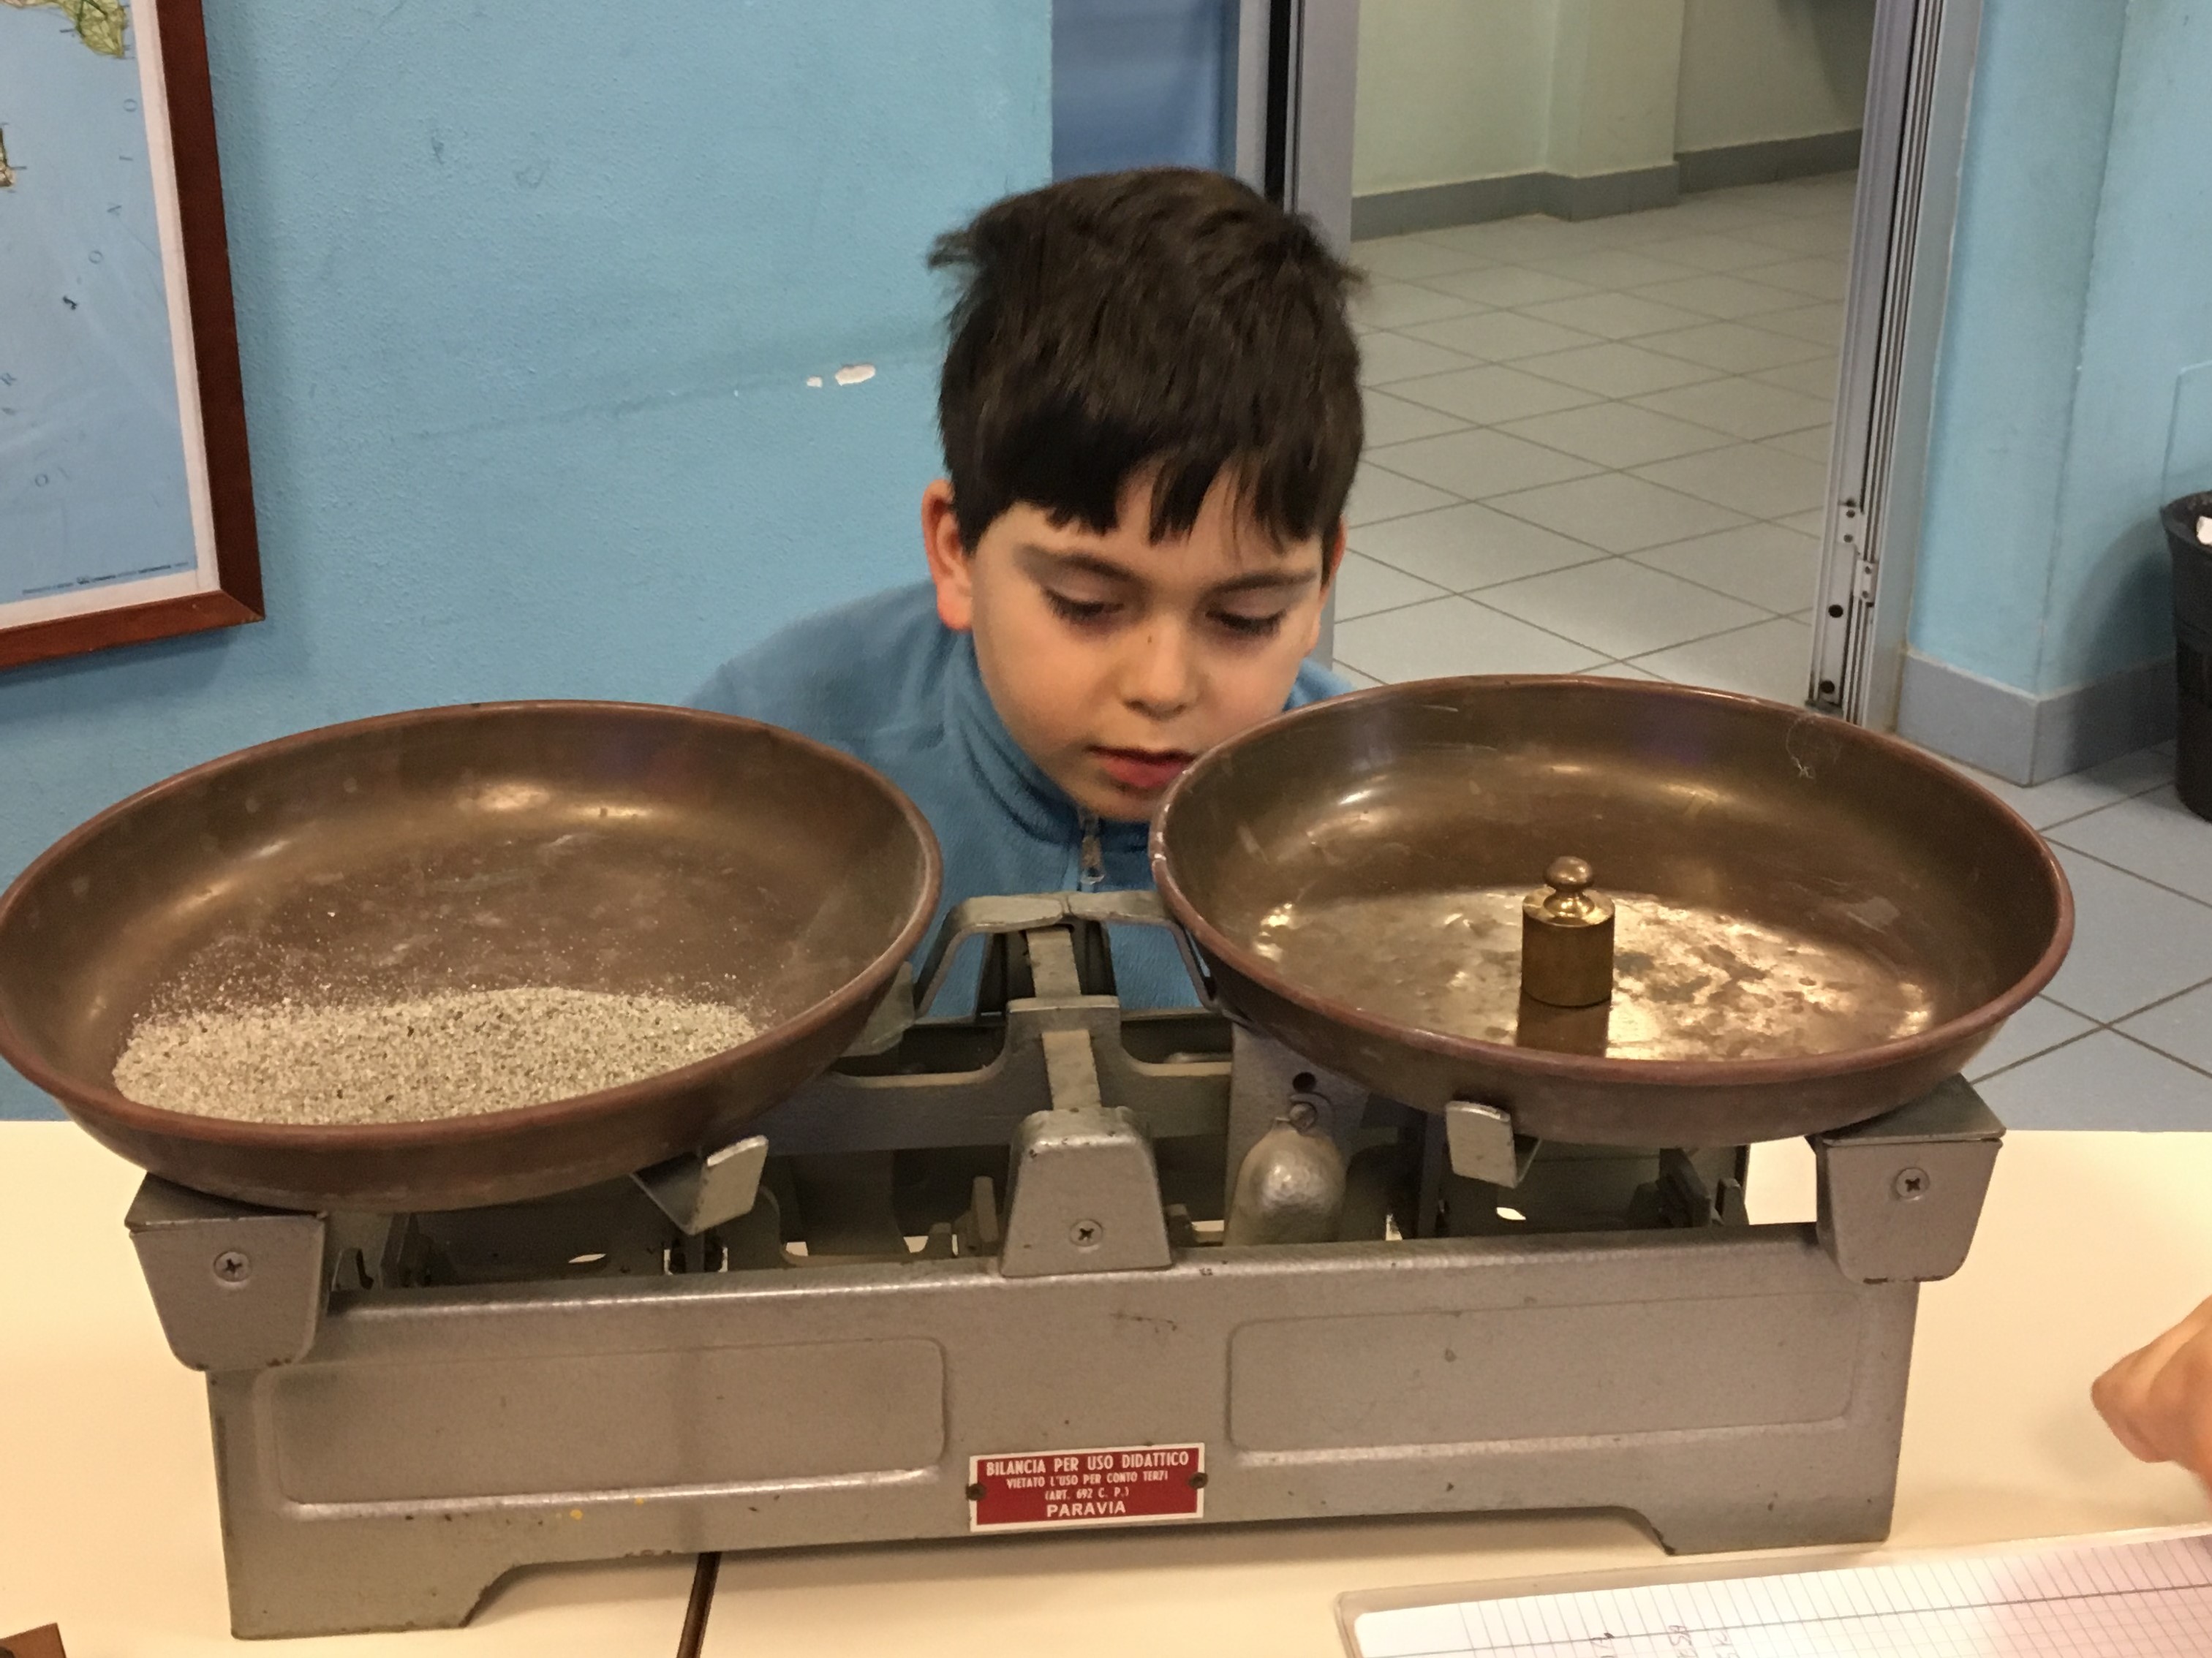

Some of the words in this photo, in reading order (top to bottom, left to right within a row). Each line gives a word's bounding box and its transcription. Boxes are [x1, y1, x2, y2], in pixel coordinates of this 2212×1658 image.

[986, 1459, 1046, 1477] BILANCIA
[1054, 1457, 1079, 1472] PER
[1087, 1455, 1114, 1471] USO
[1122, 1451, 1189, 1468] DIDATTICO
[1006, 1476, 1046, 1489] VIETATO
[1083, 1473, 1102, 1485] PER
[1106, 1471, 1138, 1483] CONTO
[1143, 1470, 1169, 1481] TERZI
[1076, 1488, 1092, 1499] 692
[1046, 1500, 1126, 1518] PARAVIA
